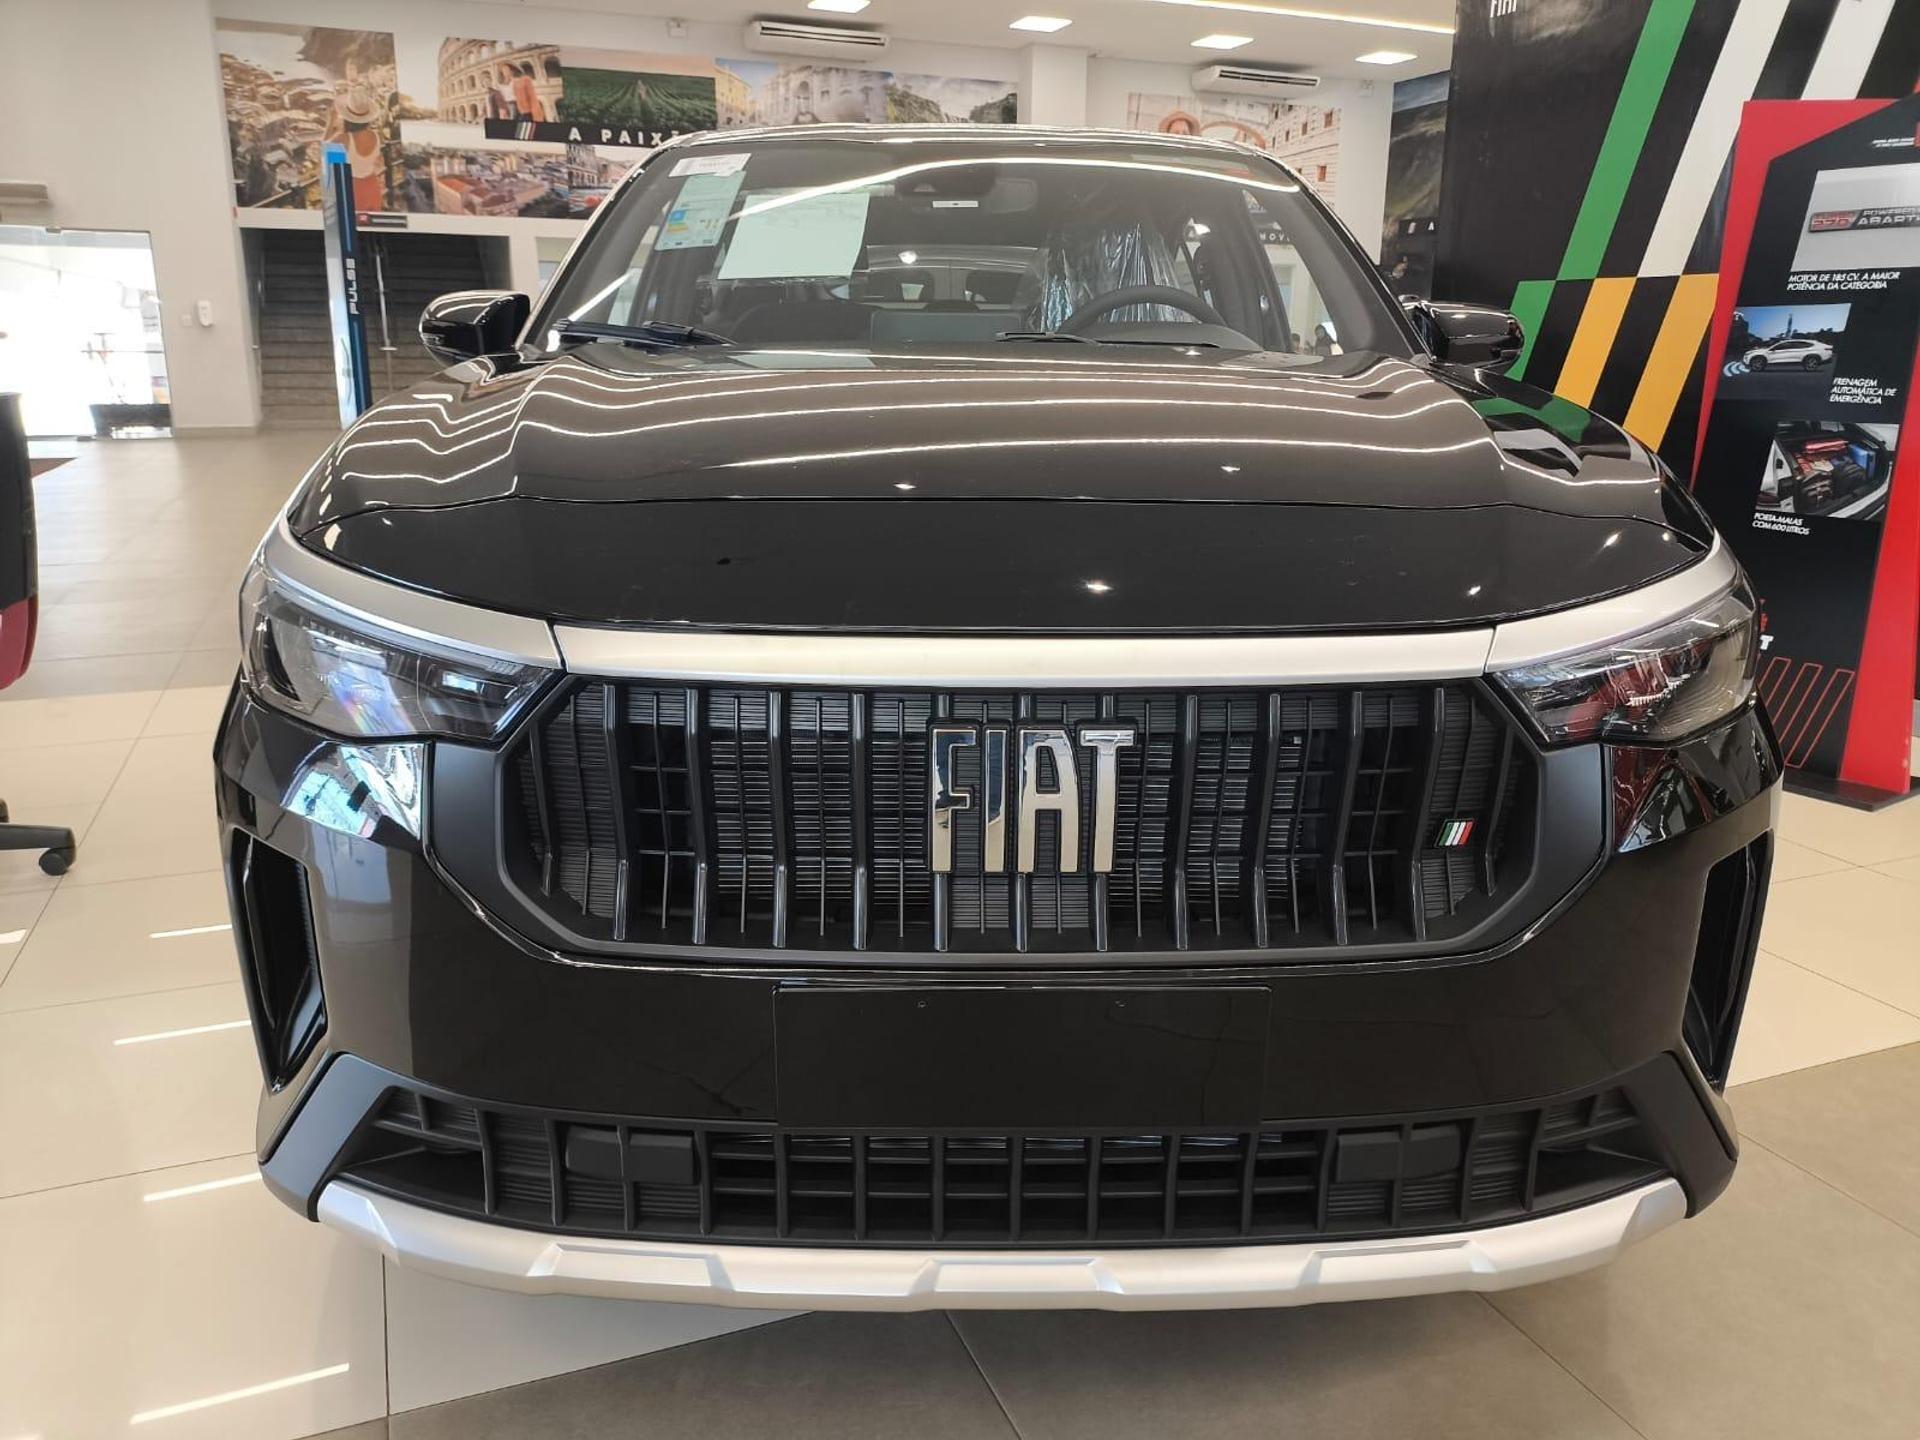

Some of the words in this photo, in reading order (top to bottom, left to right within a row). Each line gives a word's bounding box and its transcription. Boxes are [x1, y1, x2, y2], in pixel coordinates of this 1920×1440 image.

[569, 127, 582, 141] A
[1788, 274, 1818, 282] MOTOR
[1819, 274, 1831, 282] DE
[1861, 272, 1869, 281] A
[1870, 271, 1901, 280] MAIOR
[345, 258, 360, 315] PULSE
[1786, 280, 1825, 291] POTÊNCIA
[1826, 282, 1839, 290] DA
[1840, 280, 1887, 290] CATEGORIA
[1832, 377, 1878, 387] FRENAGEM
[1830, 386, 1883, 396] AUTOMÁTICA
[1884, 388, 1898, 396] DE
[1829, 394, 1882, 404] EMERGÊNCIA
[1752, 520, 1771, 529] COM
[1754, 512, 1804, 526] PORTA-MALAS
[932, 729, 1136, 873] FIAT
